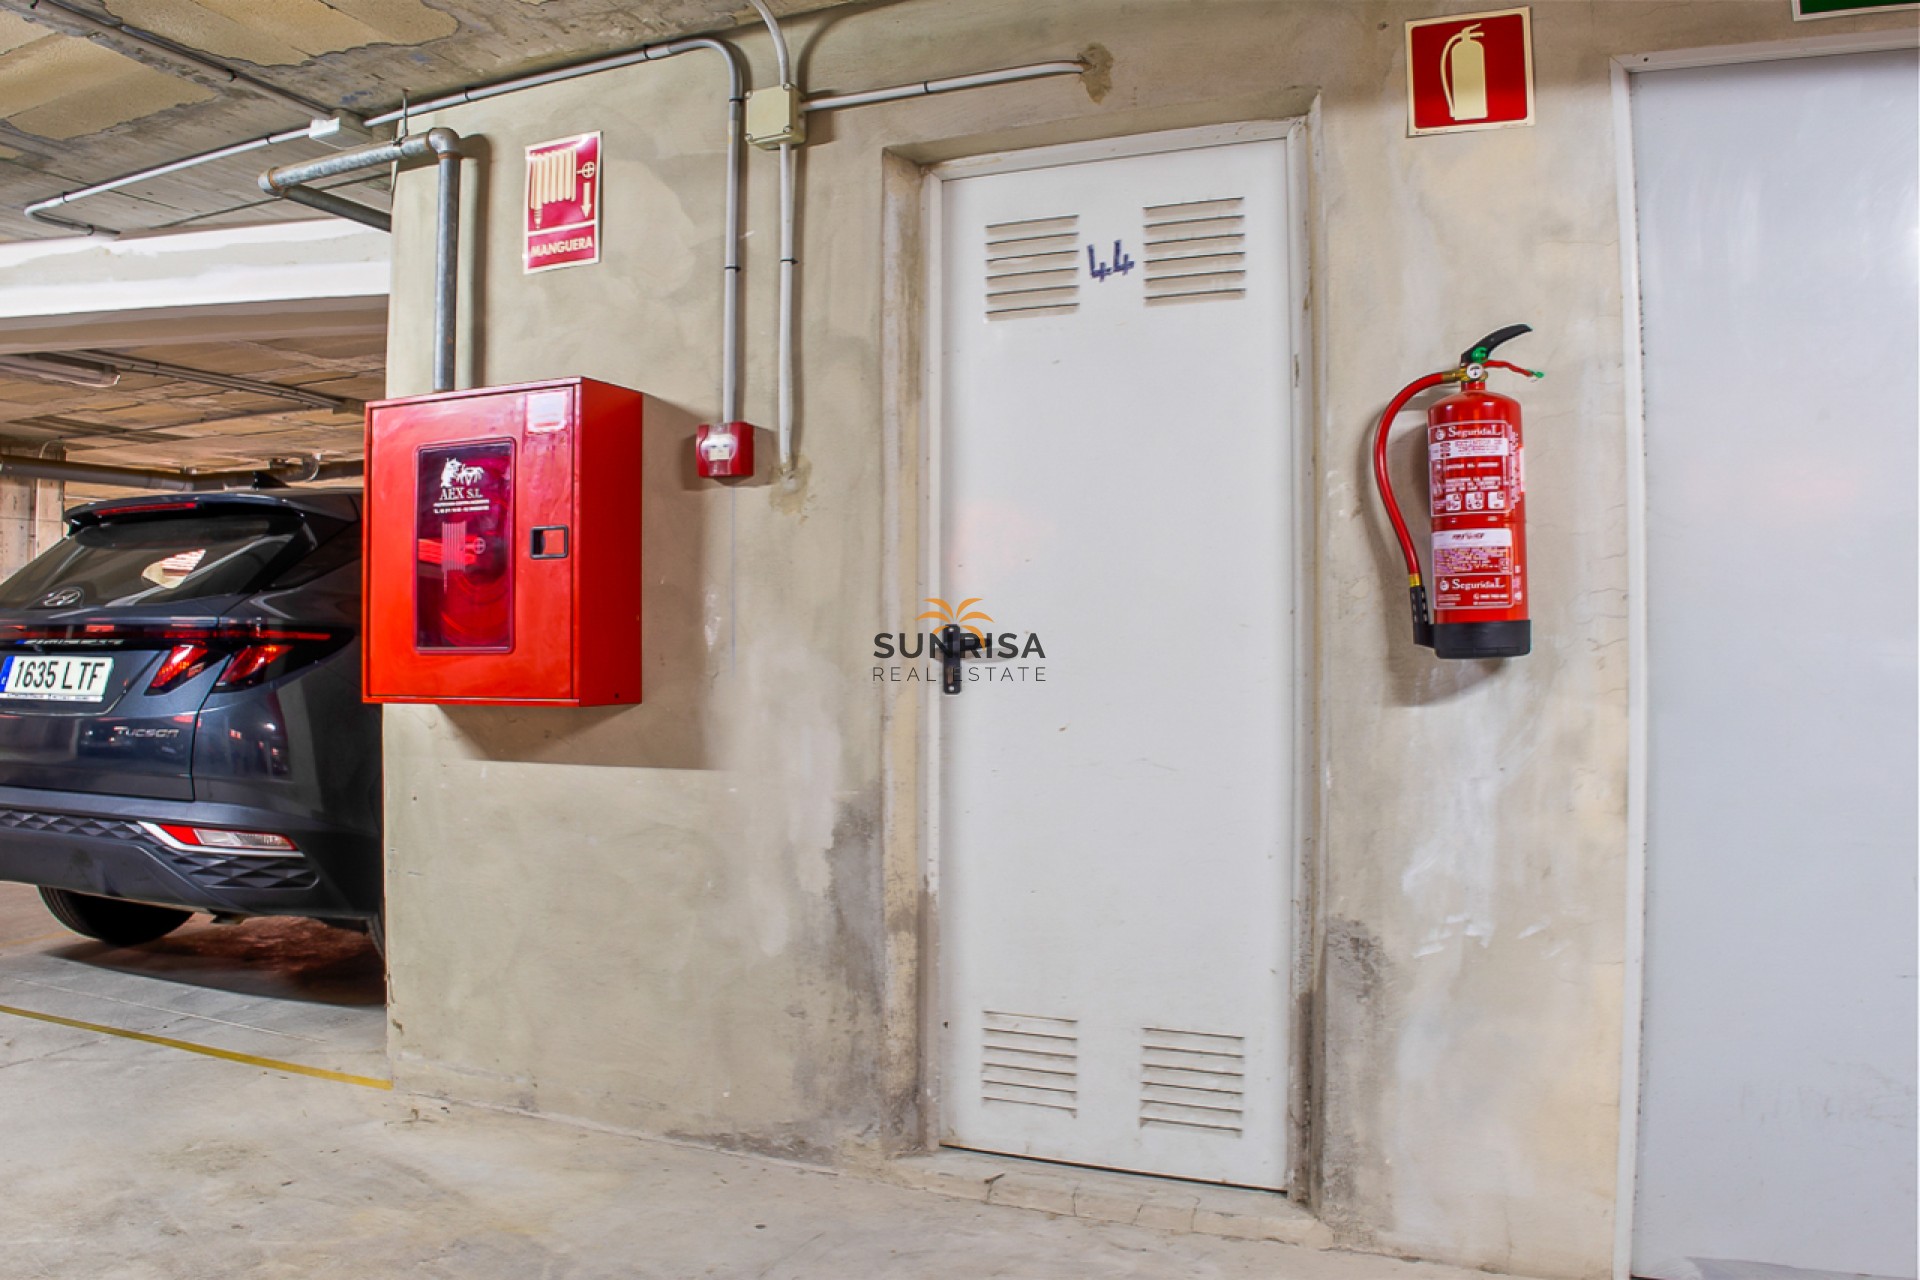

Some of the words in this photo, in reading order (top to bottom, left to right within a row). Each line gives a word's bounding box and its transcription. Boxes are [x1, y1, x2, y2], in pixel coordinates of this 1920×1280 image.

[530, 235, 593, 258] MANGUERA
[1087, 239, 1135, 283] 44
[438, 487, 465, 501] AEX
[14, 659, 60, 689] 1635
[61, 660, 106, 691] LTF
